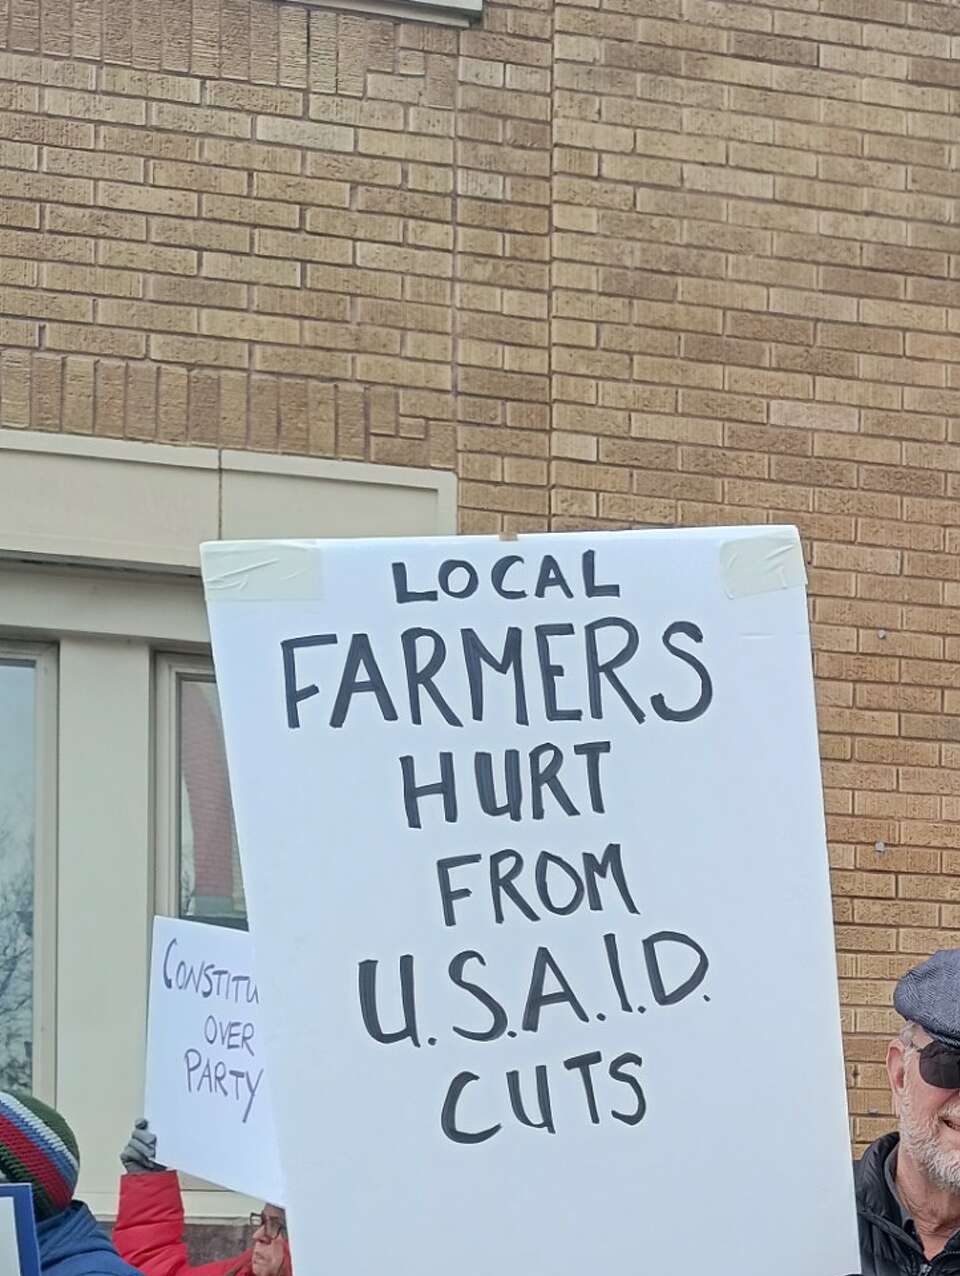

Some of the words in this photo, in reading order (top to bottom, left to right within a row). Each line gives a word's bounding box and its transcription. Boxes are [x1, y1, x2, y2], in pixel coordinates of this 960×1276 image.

[392, 549, 620, 604] LOCAL
[280, 616, 713, 729] FARMERS
[400, 741, 612, 829] HURT
[437, 843, 640, 926] FROM
[162, 938, 260, 1004] CONSTITU
[358, 931, 711, 1048] U.S.A.I.D.
[204, 1015, 255, 1057] OVER
[184, 1048, 264, 1123] PARTY
[441, 1051, 647, 1144] CUTS
